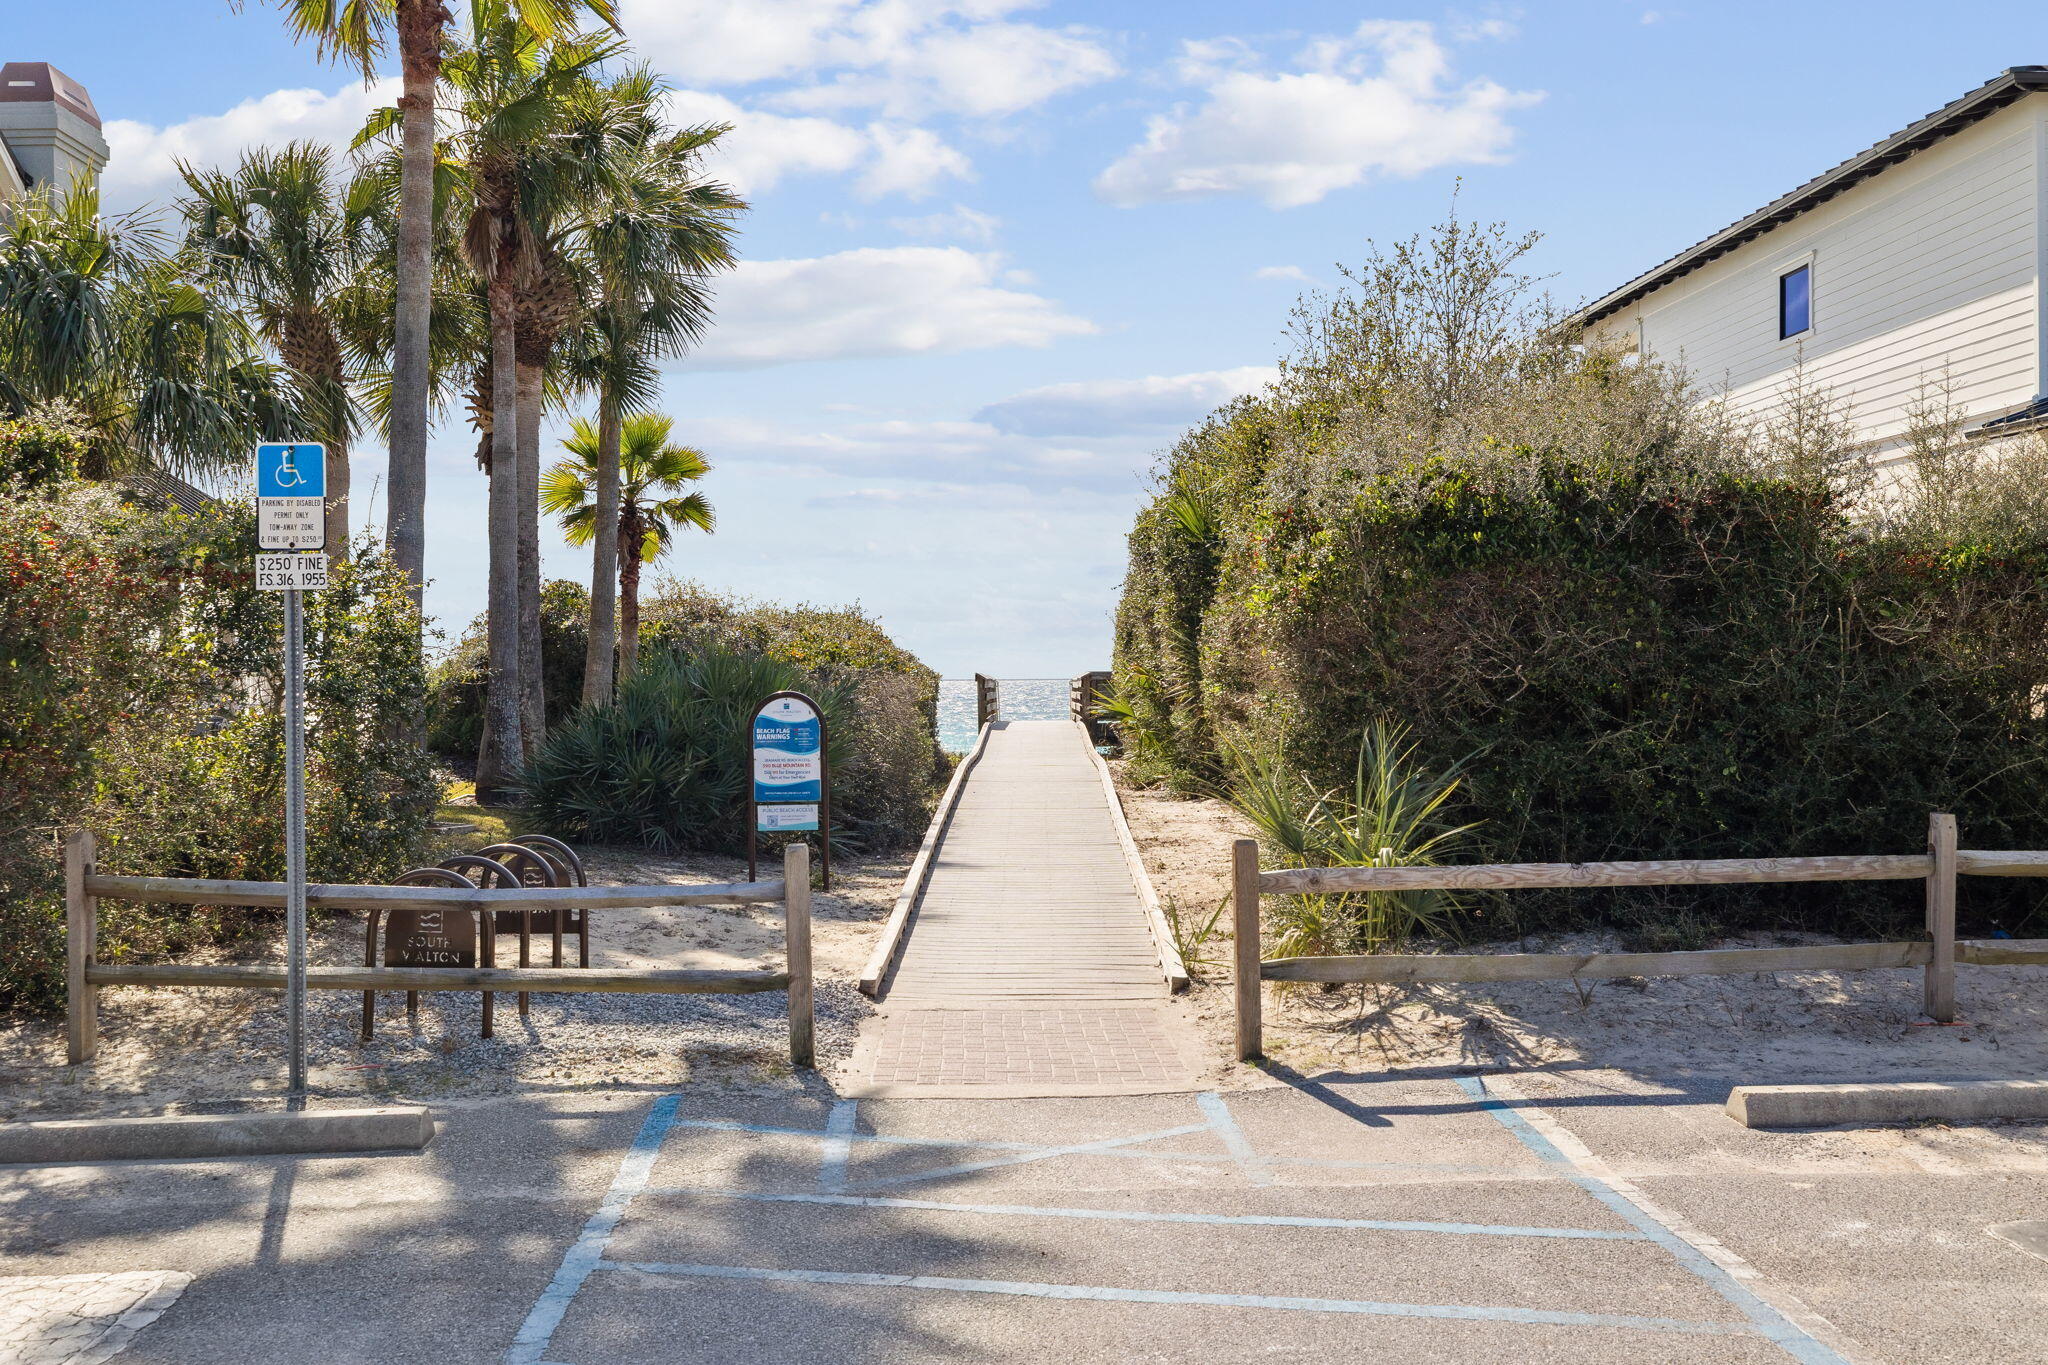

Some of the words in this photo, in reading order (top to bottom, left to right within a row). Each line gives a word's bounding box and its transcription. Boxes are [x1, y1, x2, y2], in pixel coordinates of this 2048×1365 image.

[261, 499, 284, 507] PARKING
[286, 499, 294, 507] BY
[296, 499, 321, 507] DISABLED
[274, 511, 293, 519] PERMIT
[295, 511, 309, 519] ONLY
[269, 523, 298, 531] TOW-AWAY
[300, 523, 315, 531] ZONE
[260, 535, 265, 543] &
[267, 535, 280, 543] FINE
[282, 535, 290, 543] UP
[292, 535, 299, 543] TO
[259, 557, 291, 571] $250
[297, 557, 324, 570] FINE
[302, 572, 326, 586] 1955
[407, 936, 452, 947] SOUTH
